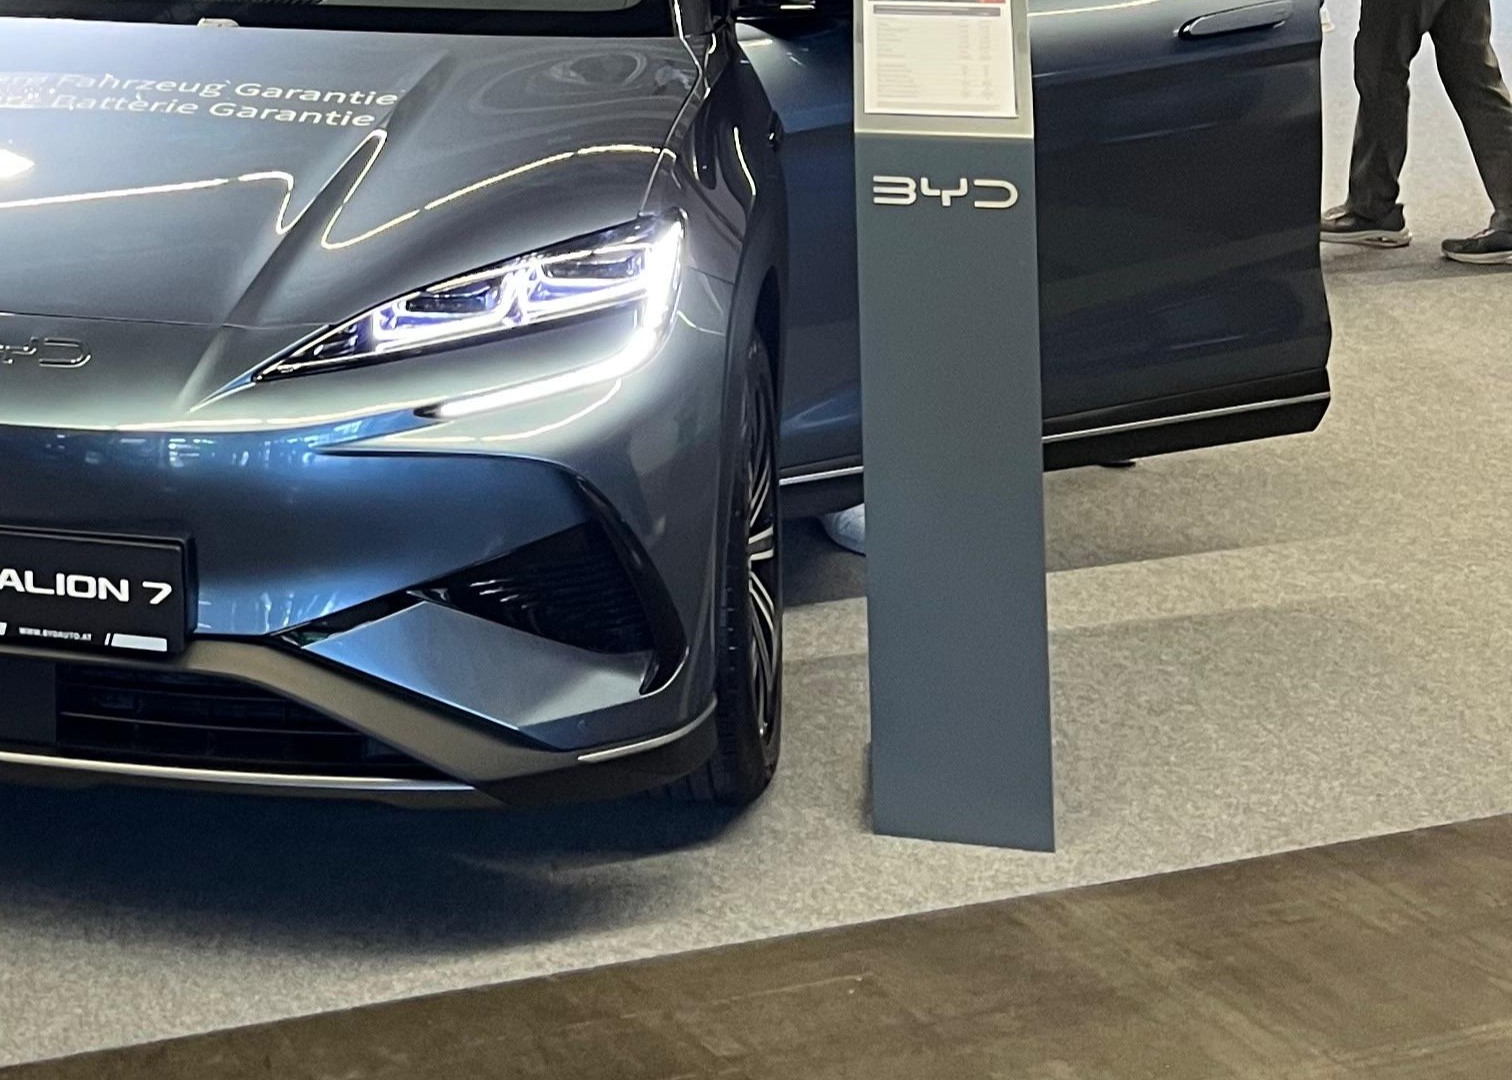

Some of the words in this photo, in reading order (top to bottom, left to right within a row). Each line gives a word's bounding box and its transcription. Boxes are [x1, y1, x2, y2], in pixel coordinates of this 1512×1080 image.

[56, 72, 231, 99] Fahrzeug
[234, 81, 400, 107] Garantie
[50, 91, 199, 116] Batterie
[208, 101, 376, 128] Garantie
[872, 174, 1019, 210] BYD
[141, 580, 173, 606] 7
